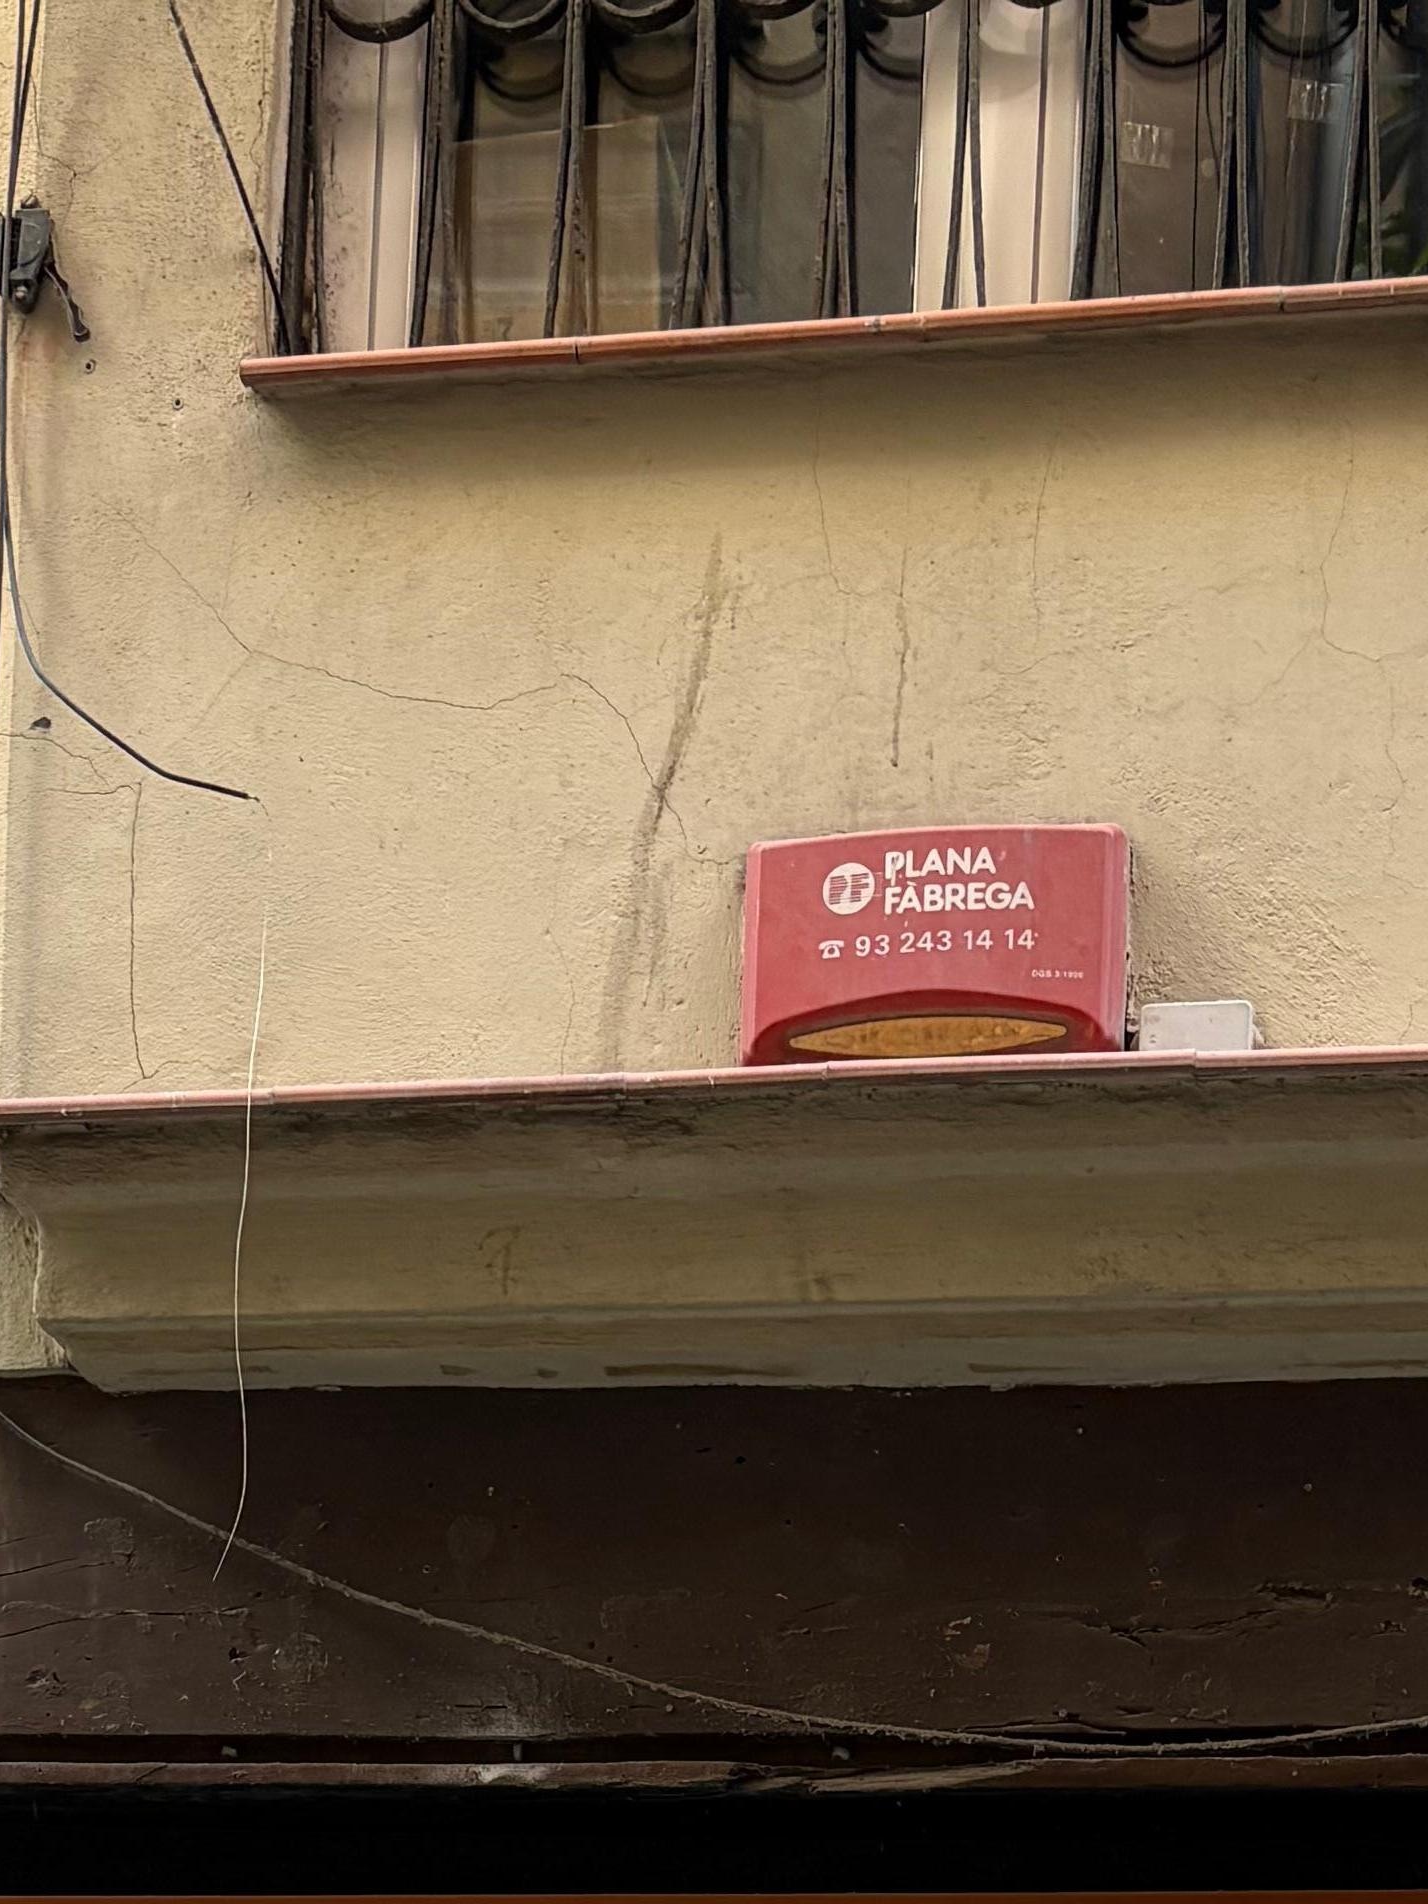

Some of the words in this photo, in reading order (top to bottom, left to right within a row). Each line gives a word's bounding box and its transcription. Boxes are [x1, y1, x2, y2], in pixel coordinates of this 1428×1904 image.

[884, 846, 996, 878] PLANA
[884, 882, 1035, 913] FÀBREGA
[855, 934, 890, 958] 93
[899, 930, 952, 954] 243
[963, 929, 993, 950] 14
[1005, 928, 1035, 950] 14
